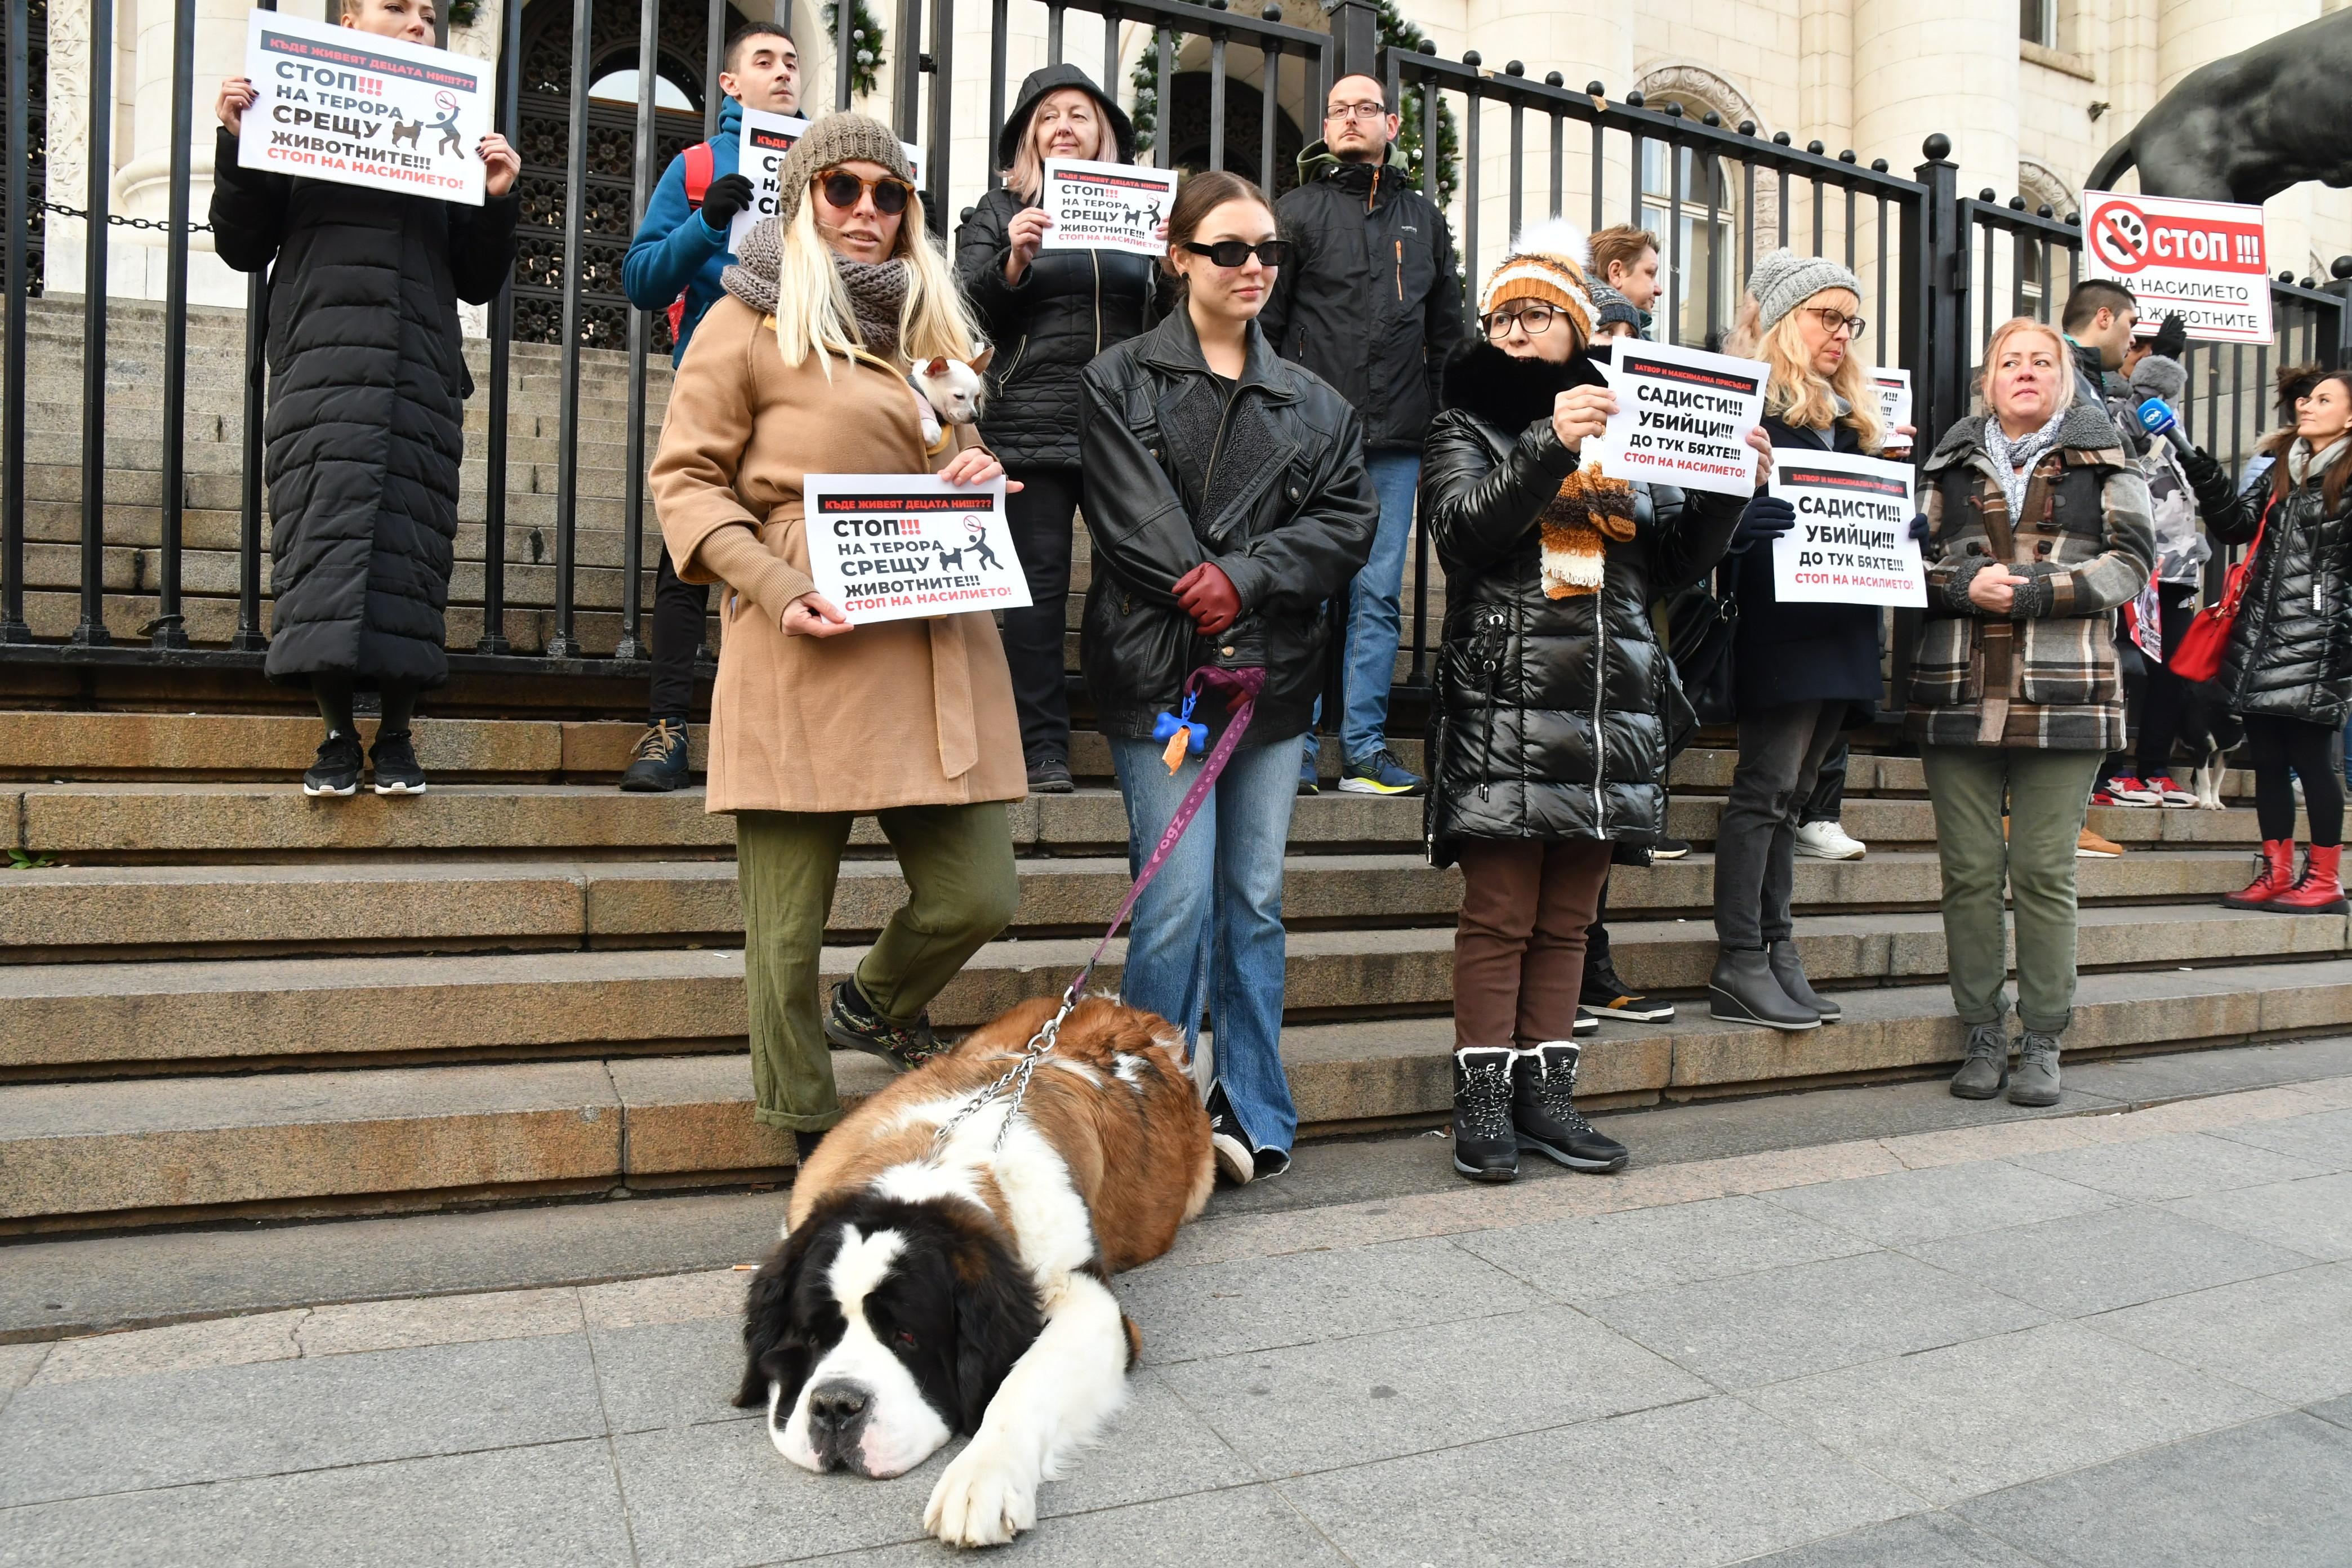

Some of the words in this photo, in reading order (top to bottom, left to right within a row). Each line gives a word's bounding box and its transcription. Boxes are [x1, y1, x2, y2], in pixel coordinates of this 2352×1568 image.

[270, 38, 308, 55] КЪДЕ
[310, 46, 366, 65] ЖИВЕЯТ
[369, 58, 423, 78] ДЕЦАТА
[275, 61, 383, 97] СТОП!!!
[276, 84, 309, 103] НА
[317, 91, 403, 121] ТЕРОРА
[273, 105, 382, 140] СРЕЩУ
[271, 131, 431, 170] ЖИВОТНИТЕ!!!
[757, 135, 786, 149] КЪДЕ
[268, 148, 315, 165] СТОП
[321, 155, 346, 170] НА
[353, 161, 464, 189] НАСИЛИЕТО!
[1061, 184, 1118, 198] СТОП!!!
[1111, 179, 1139, 188] ДЕЦАТА
[1084, 199, 1130, 210] ТЕРОРА
[1061, 210, 1119, 222] СРЕЩУ
[1060, 224, 1144, 239] ЖИВОТНИТЕ!!!
[1104, 235, 1162, 250] НАСИЛИЕТО!
[2153, 226, 2228, 262] СТОП
[2236, 234, 2260, 265] !!!
[2141, 279, 2248, 300] НАСИЛИЕТО
[1634, 364, 1661, 375] ЗАТВОР
[1668, 369, 1714, 384] МАКСИМАЛНА
[1637, 385, 1742, 417] САДИСТИ!!!
[1638, 411, 1734, 439] УБИЙЦИ!!!
[1630, 434, 1652, 447] ДО
[1657, 437, 1683, 452] ТУК
[1689, 442, 1740, 460] БЯХТЕ!!!
[1624, 452, 1655, 465] СТОП
[1658, 457, 1673, 468] НА
[1677, 460, 1745, 478] НАСИЛИЕТО!
[825, 500, 856, 511] КЪДЕ
[858, 500, 903, 509] ЖИВЕЯТ
[905, 500, 949, 510] ДЕЦАТА
[1799, 496, 1900, 523] САДИСТИ!!!
[833, 519, 921, 537] СТОП!!!
[1805, 523, 1895, 550] УБИЙЦИ!!!
[838, 543, 866, 555] НА
[870, 540, 944, 554] ТЕРОРА
[841, 557, 929, 576] СРЕЩУ
[1799, 552, 1823, 567] ДО
[1828, 553, 1854, 567] ТУК
[1858, 555, 1904, 572] БЯХТЕ!!!
[844, 576, 980, 598] ЖИВОТНИТЕ!!!
[1795, 573, 1829, 583] СТОП
[1833, 574, 1848, 585] НА
[1852, 576, 1914, 590] НАСИЛИЕТО!
[845, 597, 886, 612] СТОП
[891, 595, 912, 607] НА
[917, 587, 1012, 604] НАСИЛИЕТО!
